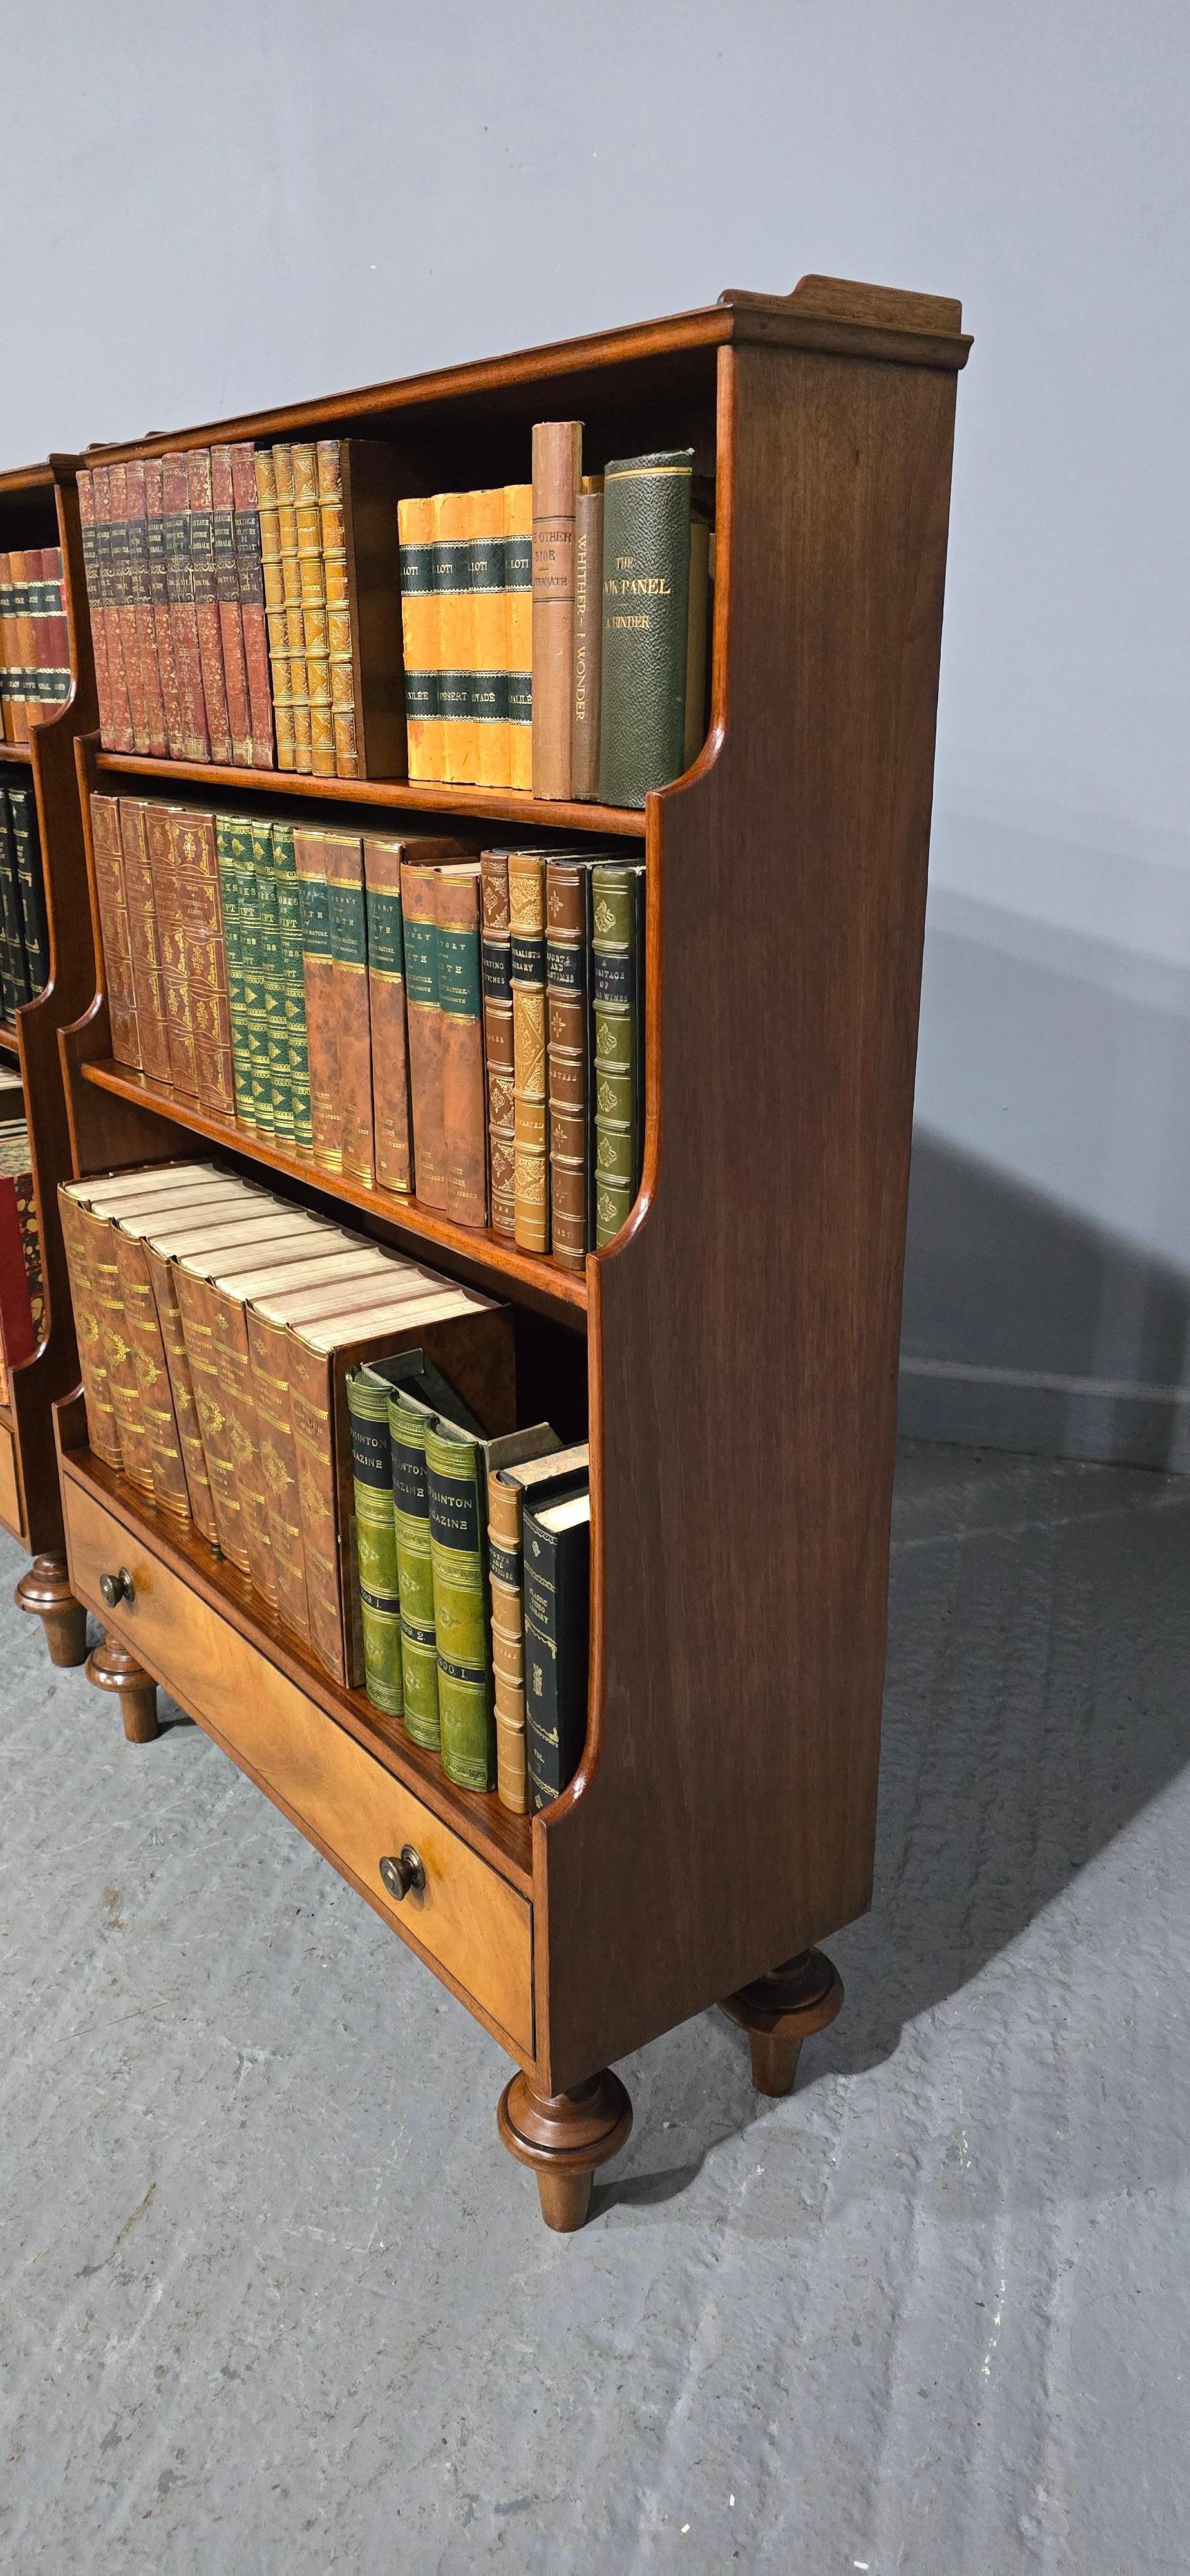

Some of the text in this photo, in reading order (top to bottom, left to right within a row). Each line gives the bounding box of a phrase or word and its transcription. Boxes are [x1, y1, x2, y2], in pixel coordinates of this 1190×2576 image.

[539, 531, 572, 543] OTHER
[534, 549, 556, 562] SIDE
[437, 564, 453, 573] LOTI
[471, 562, 487, 571] LOTI
[511, 559, 529, 569] LOTI
[403, 566, 419, 575] LOTI
[577, 535, 587, 614] WHITHER
[621, 578, 671, 594] PANEL
[576, 647, 586, 721] WONDER
[600, 981, 609, 989] OF
[529, 1587, 547, 1607] CLASSIC
